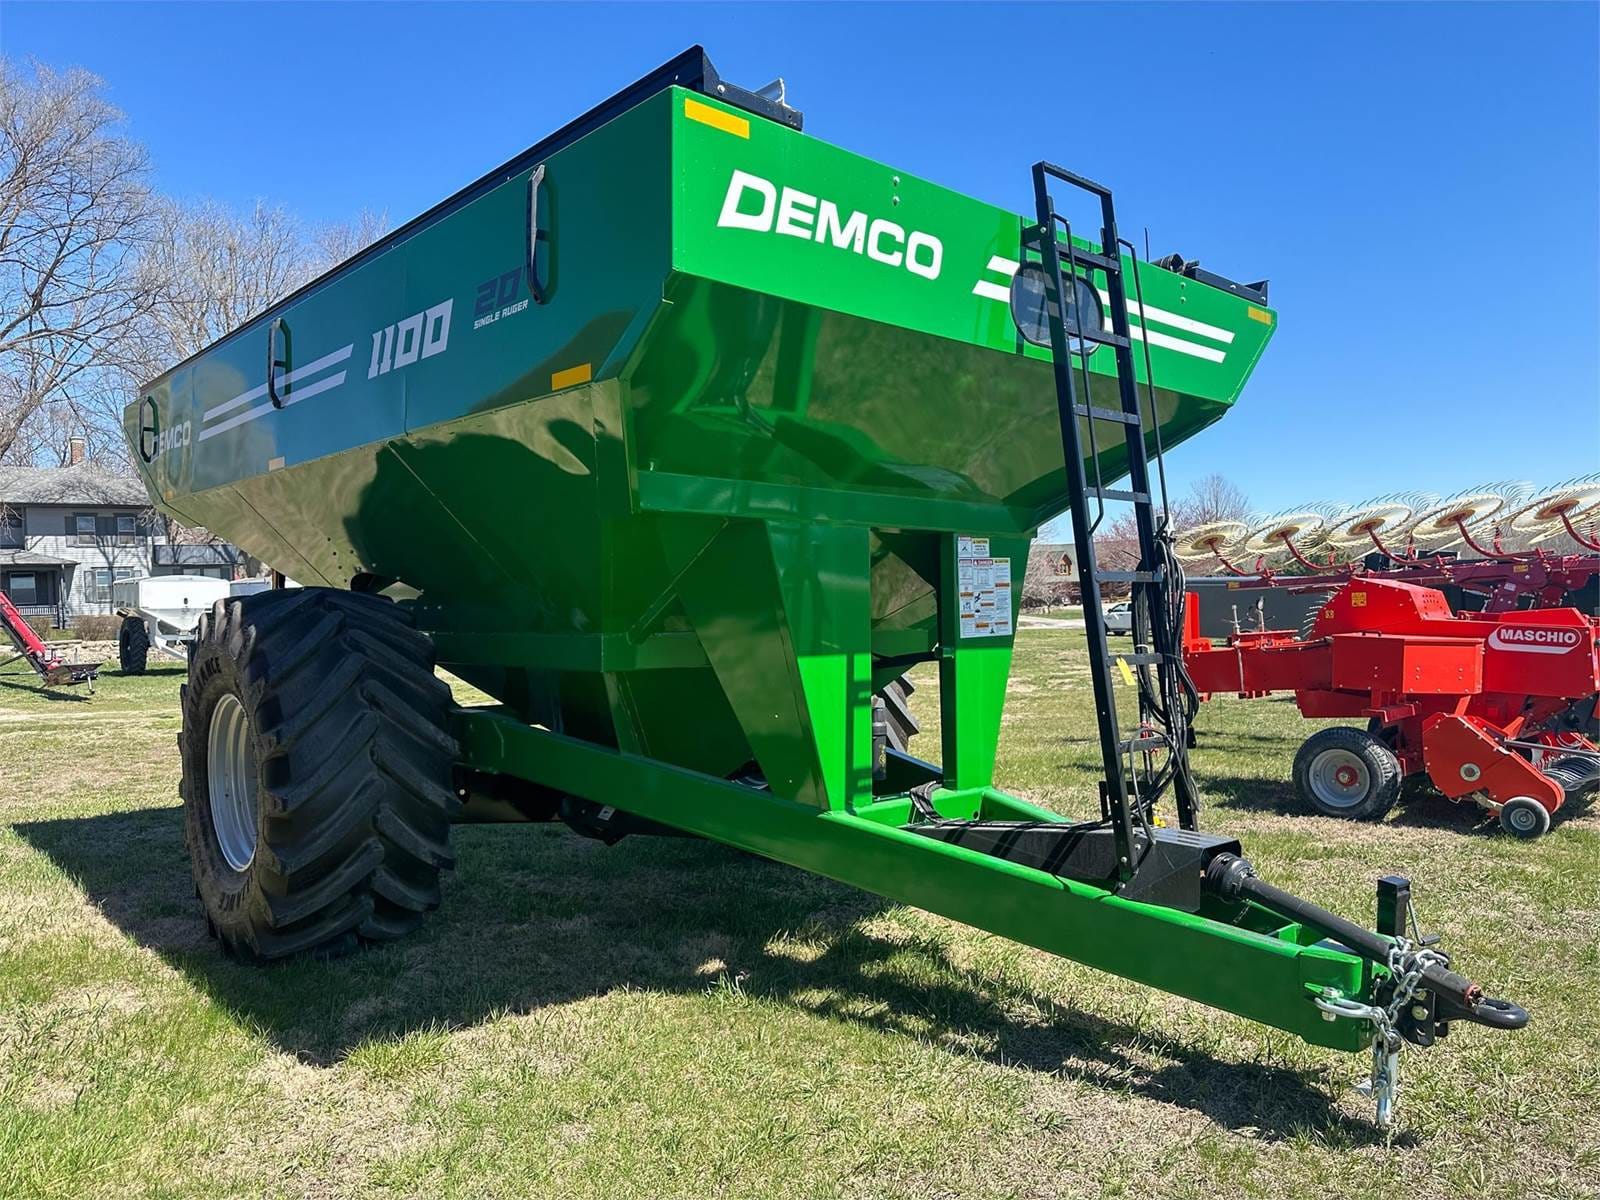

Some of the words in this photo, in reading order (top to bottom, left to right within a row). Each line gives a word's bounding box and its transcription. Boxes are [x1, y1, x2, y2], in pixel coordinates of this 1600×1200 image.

[716, 169, 943, 280] DEMCO
[367, 298, 453, 379] 1100
[473, 311, 501, 330] SINGLE
[502, 299, 529, 318] AUGER
[1500, 629, 1577, 643] MASCHIO
